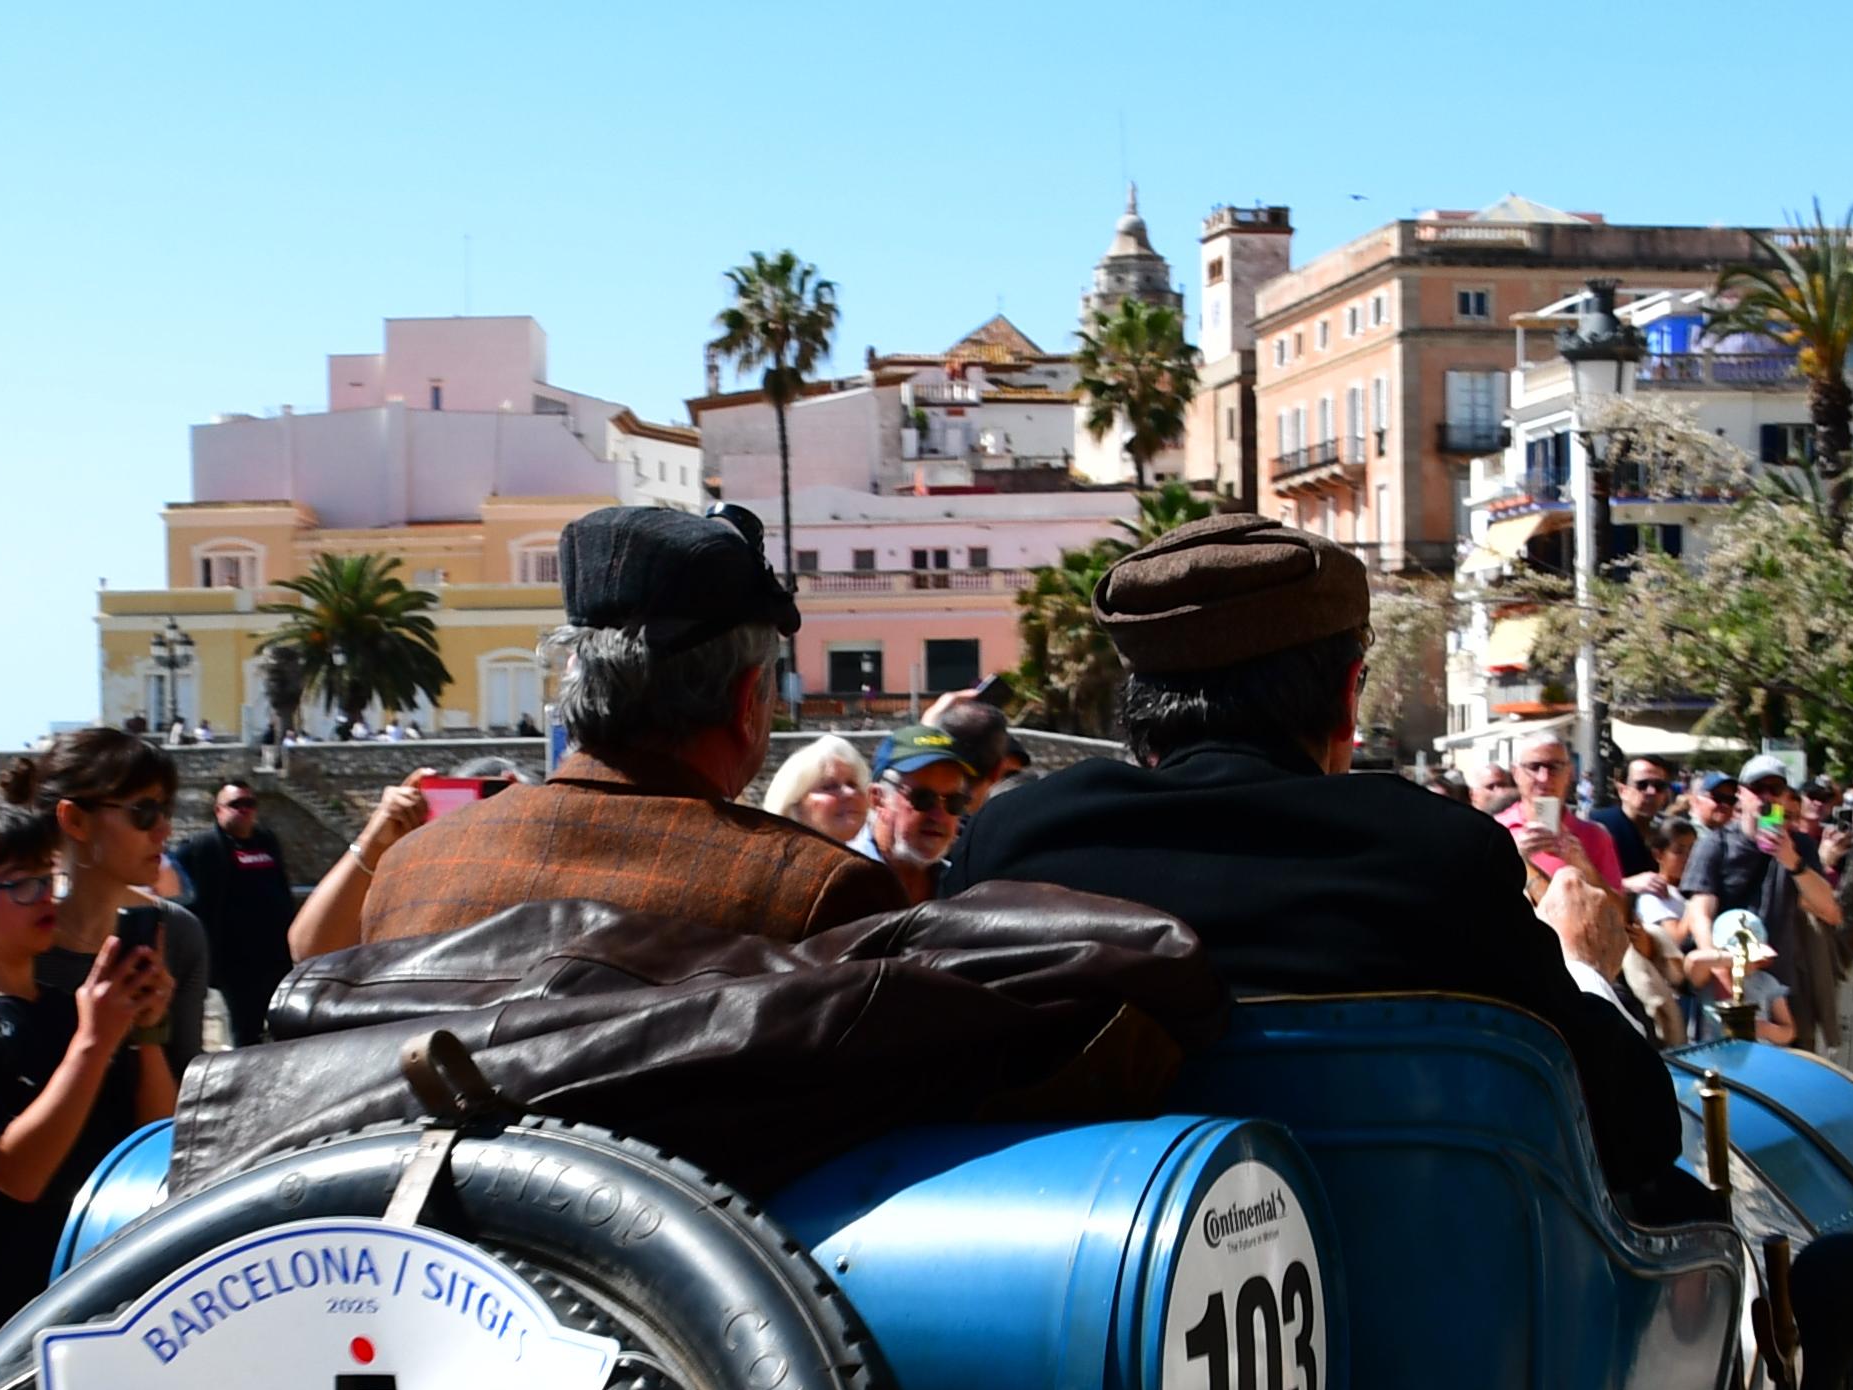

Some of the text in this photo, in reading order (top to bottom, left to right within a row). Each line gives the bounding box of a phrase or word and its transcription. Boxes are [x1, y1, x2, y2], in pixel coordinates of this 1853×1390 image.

[1203, 1190, 1278, 1250] Continental
[142, 1247, 382, 1366] BARCELONA
[326, 1297, 379, 1315] 2025
